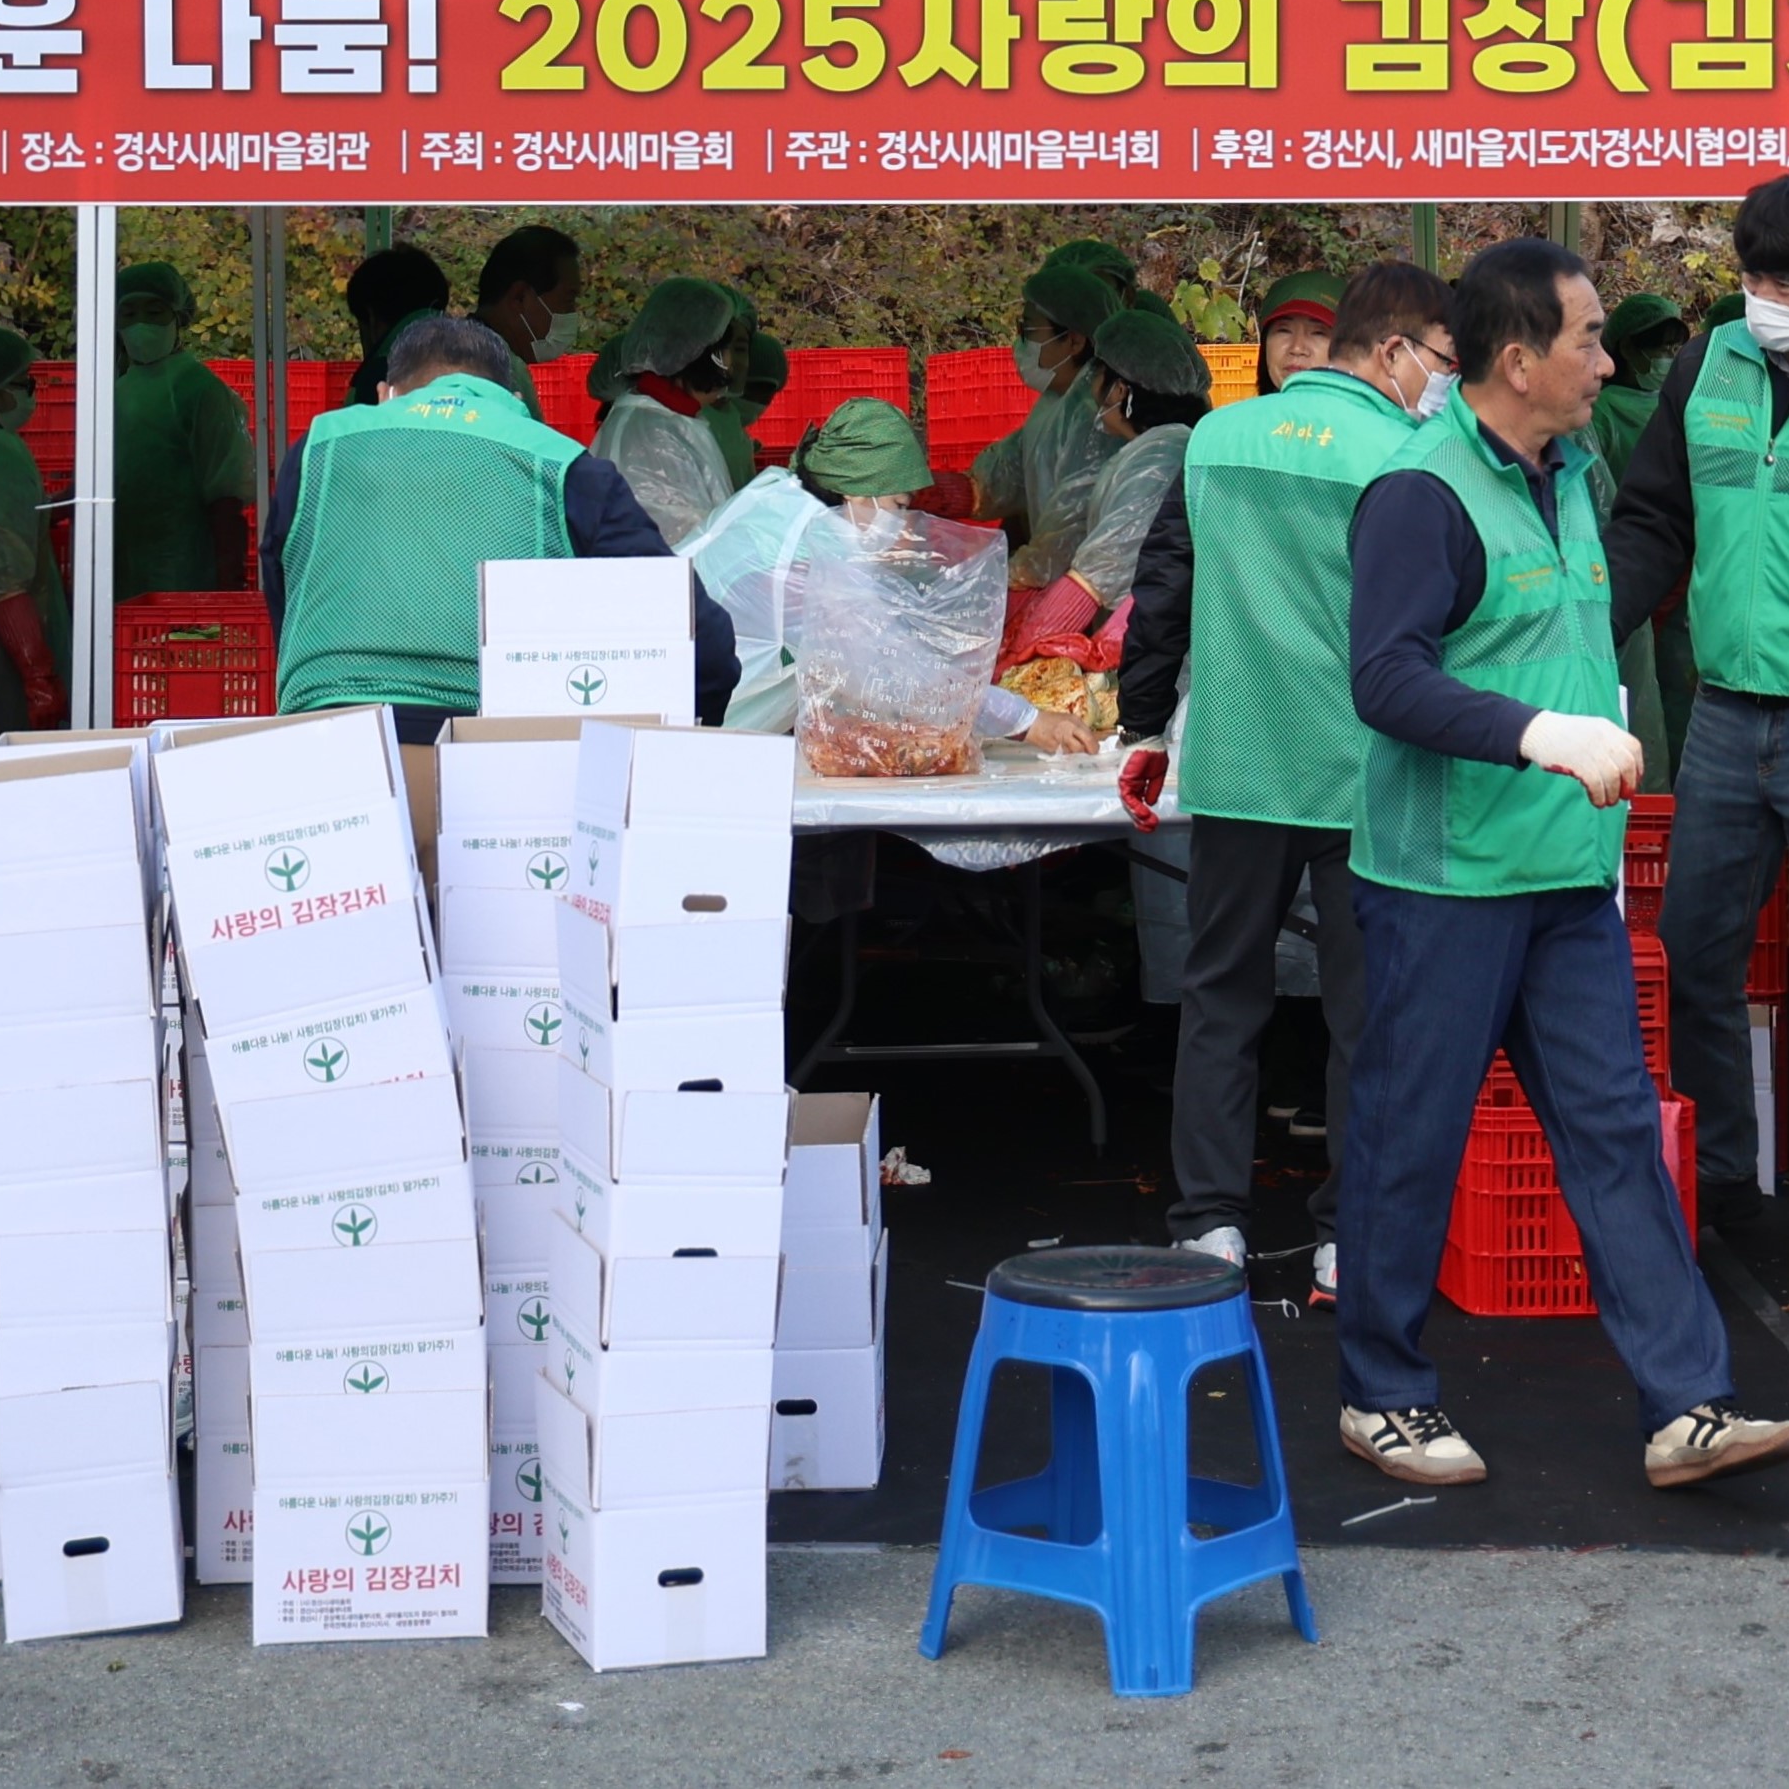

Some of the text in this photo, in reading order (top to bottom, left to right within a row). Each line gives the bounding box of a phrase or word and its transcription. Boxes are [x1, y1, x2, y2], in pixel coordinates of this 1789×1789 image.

[22, 132, 85, 171] 장소
[114, 132, 369, 171] 경산시새마을회관
[421, 132, 482, 170] 주최
[513, 131, 732, 171] 경산시새마을회
[786, 131, 850, 170] 주관
[877, 130, 1158, 170] 경산시새마을부녀회
[1211, 129, 1273, 168] 후원
[1303, 129, 1402, 169] 경산시,
[462, 837, 498, 850] 아름다운
[524, 835, 572, 849] 사랑의김장(
[211, 883, 387, 941] 사랑의 김장김치
[279, 1496, 316, 1510] 아름다운
[420, 1491, 458, 1505] 담가주기
[282, 1563, 461, 1595] 사랑의 김장김치
